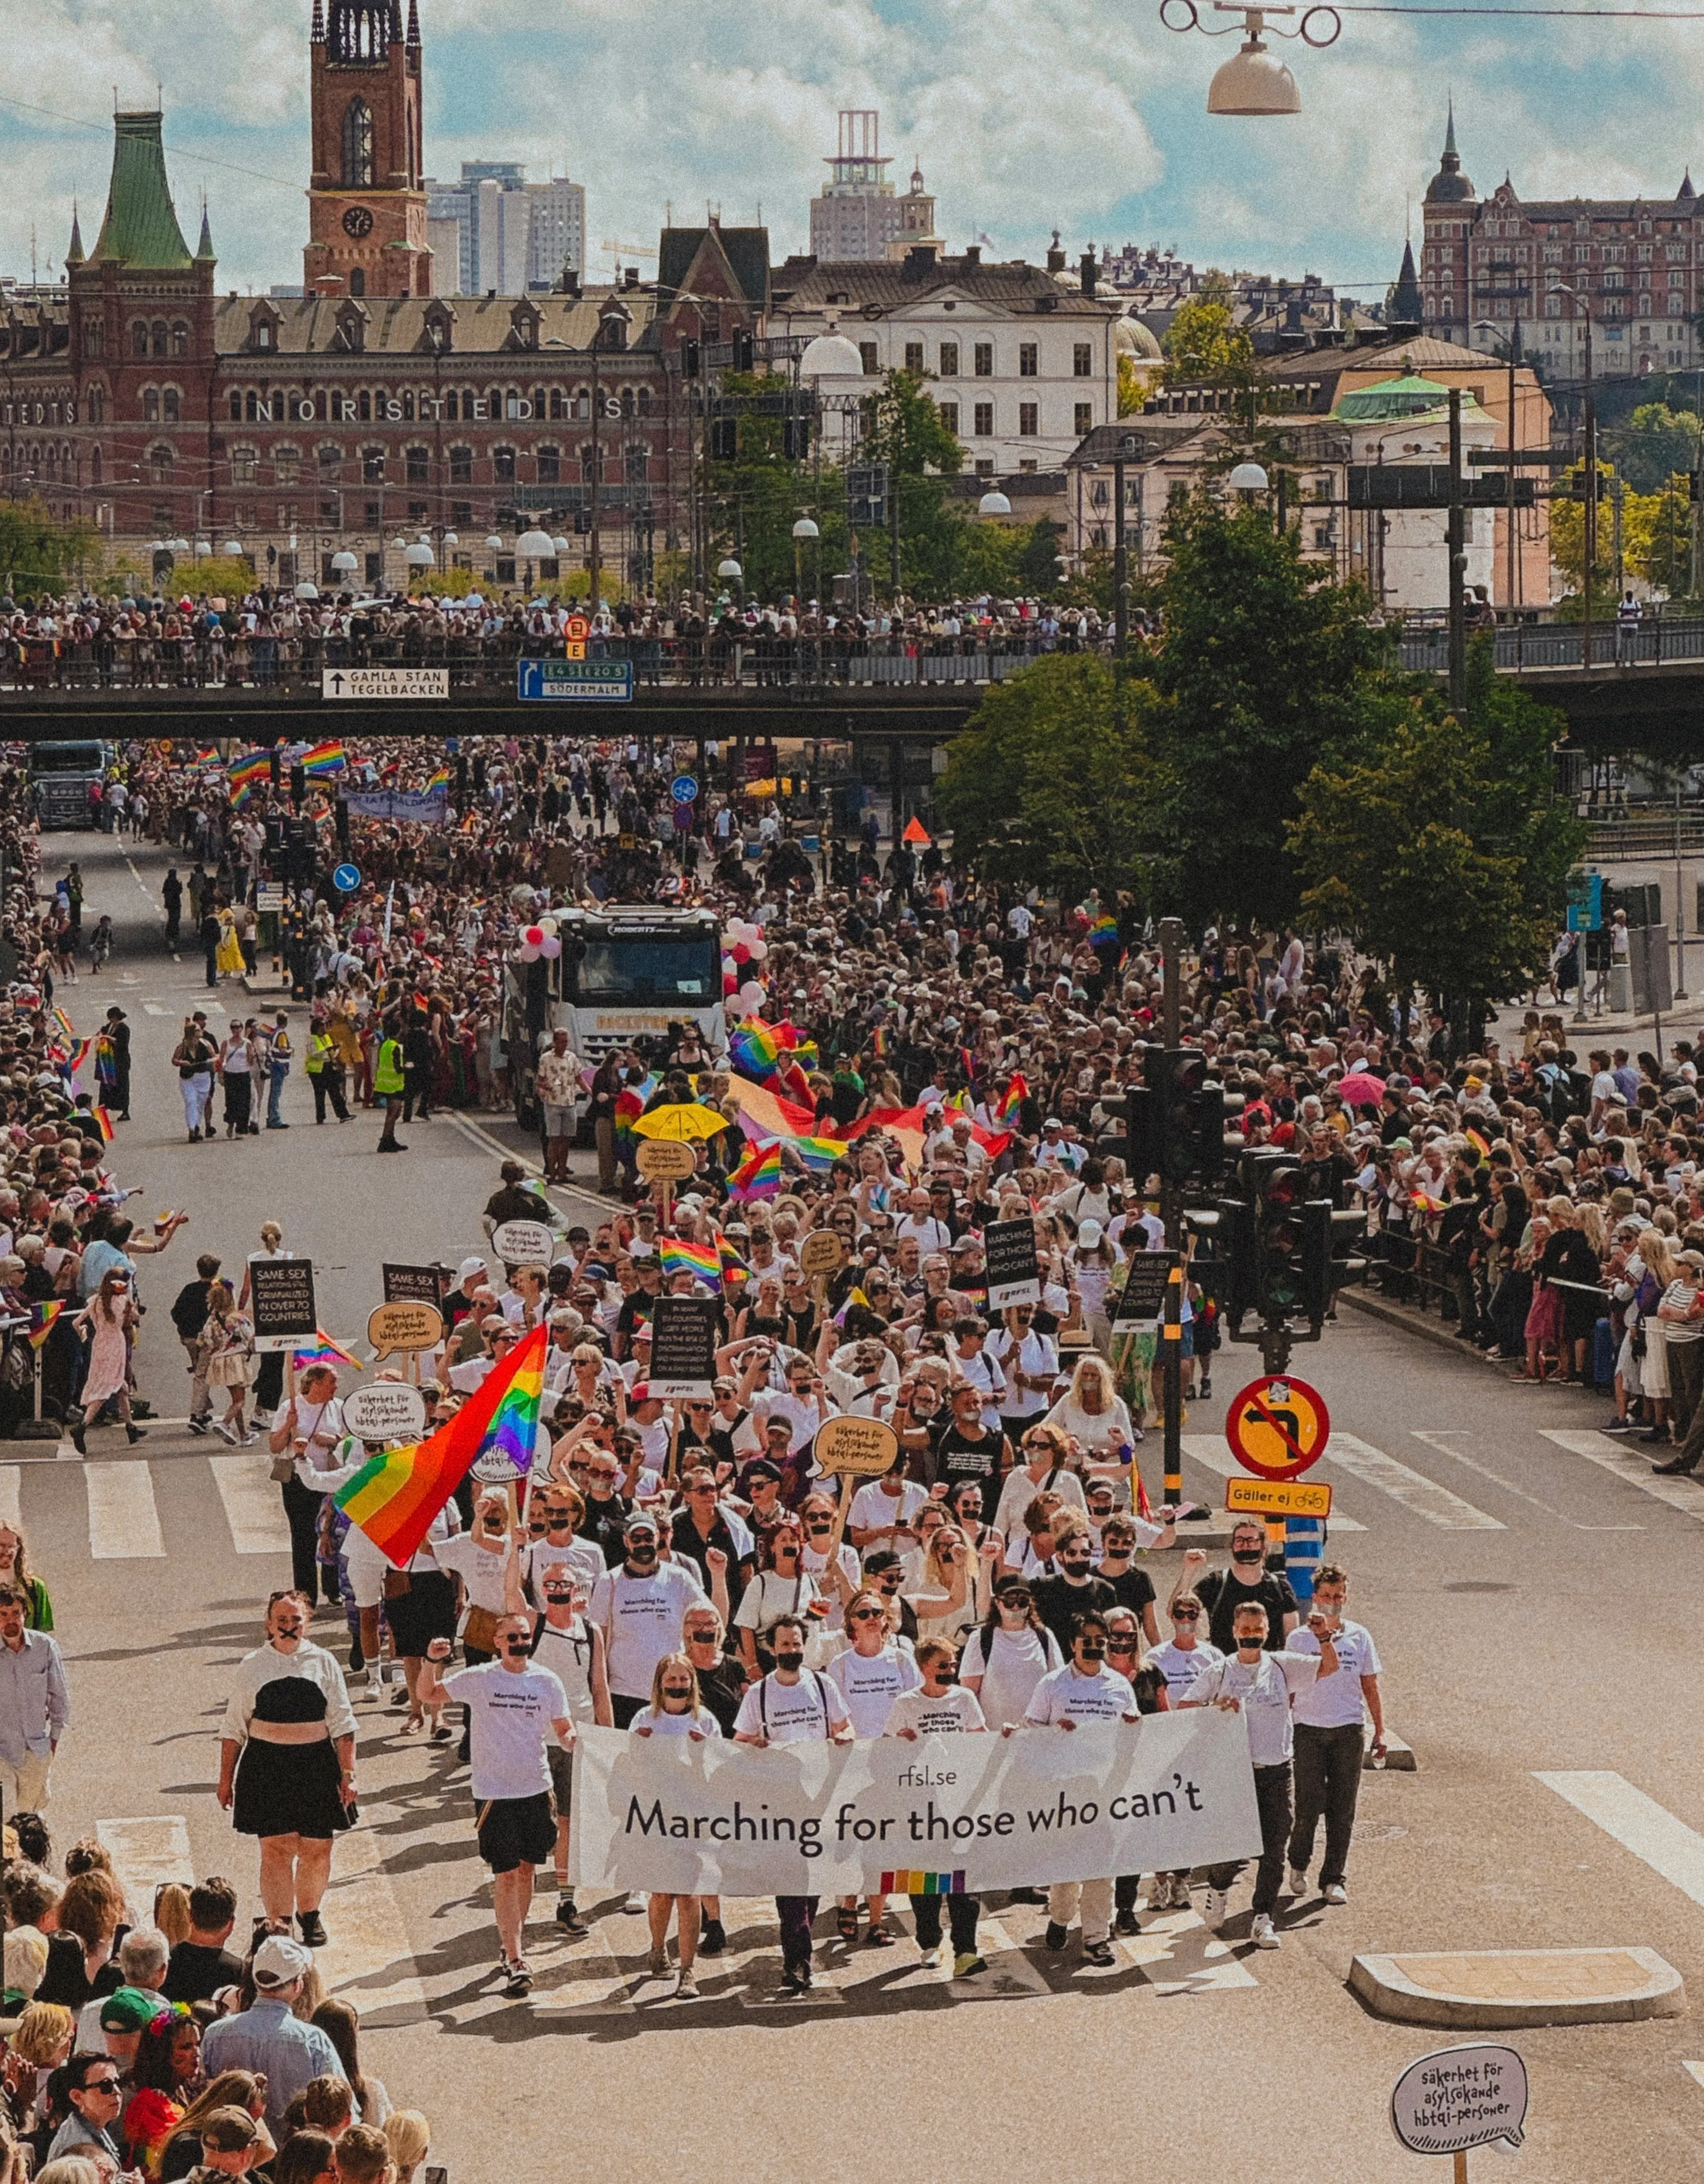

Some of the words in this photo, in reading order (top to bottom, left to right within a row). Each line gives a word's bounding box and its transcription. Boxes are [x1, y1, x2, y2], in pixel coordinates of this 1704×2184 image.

[256, 398, 622, 422] NORSTEDTS
[573, 645, 579, 657] E
[350, 672, 396, 682] GAMLA
[406, 672, 441, 682] STAN
[351, 685, 444, 694] TEGELBACKEN
[550, 683, 619, 693] SÖDERMALM
[988, 1229, 1032, 1244] MARCHING
[989, 1248, 1005, 1259] FOR
[1007, 1243, 1033, 1256] THOSE
[1011, 1287, 1031, 1295] RFSL
[260, 1311, 311, 1321] COUNTRIES
[1234, 1489, 1273, 1502] Gäller
[1278, 1492, 1290, 1506] ej
[923, 1711, 961, 1720] Marching
[899, 1765, 957, 1787] rfsl.se
[625, 1794, 824, 1858] Marching
[835, 1803, 896, 1841] for
[907, 1801, 1015, 1841] those
[1027, 1791, 1099, 1833] who
[1109, 1773, 1204, 1820] can't
[1421, 2065, 1479, 2089] säkerhet
[1483, 2062, 1503, 2081] för
[1424, 2081, 1501, 2111] asylsökande
[1414, 2102, 1510, 2128] hbtqi-personer
